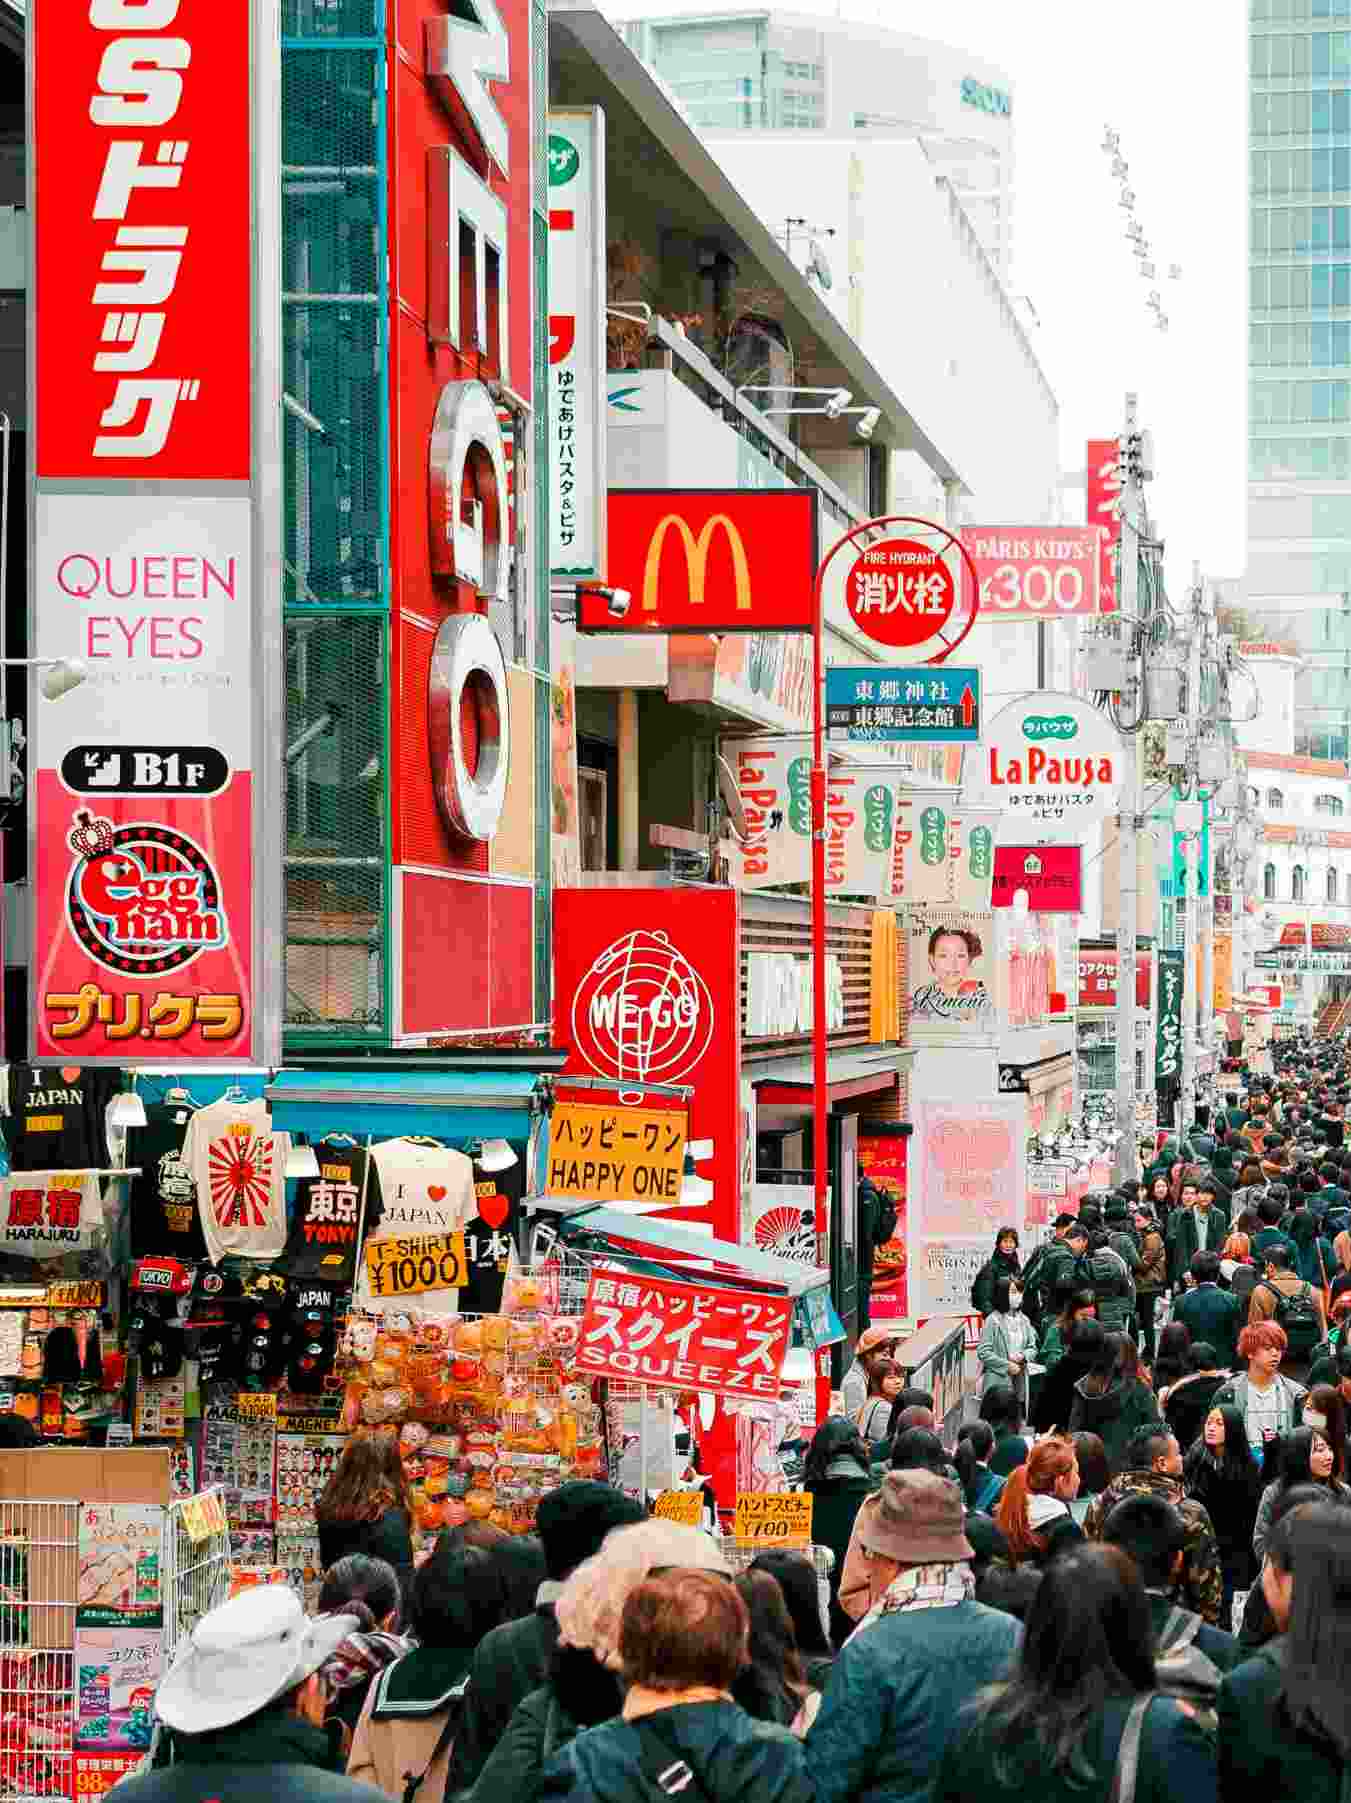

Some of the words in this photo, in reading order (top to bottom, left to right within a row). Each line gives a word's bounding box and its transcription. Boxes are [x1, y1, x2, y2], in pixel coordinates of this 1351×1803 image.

[864, 552, 886, 564] FIRE
[890, 552, 937, 565] HYDRANT
[974, 537, 1031, 560] PARIS
[56, 554, 235, 601] QUEEN
[855, 572, 947, 615] 消火栓
[87, 616, 204, 659] EYES
[855, 681, 950, 700] 東郷神社
[855, 706, 955, 727] 東郷記念館
[134, 752, 207, 786] B1F
[25, 1088, 83, 1108] JAPAN
[555, 1117, 682, 1154] ハッピーワン
[551, 1160, 625, 1191] HAPPY
[632, 1166, 679, 1197] ONE
[306, 1180, 358, 1222] 東京
[385, 1207, 448, 1225] JAPAN
[6, 1228, 81, 1242] HARAJUKU
[369, 1233, 453, 1258] T-SHIRT
[371, 1252, 460, 1293] ¥1000
[296, 1290, 331, 1306] JAPAN
[591, 1276, 787, 1329] 原宿ハッピーワン
[585, 1304, 785, 1374] スクイーズ
[579, 1345, 774, 1392] SQUEEZE
